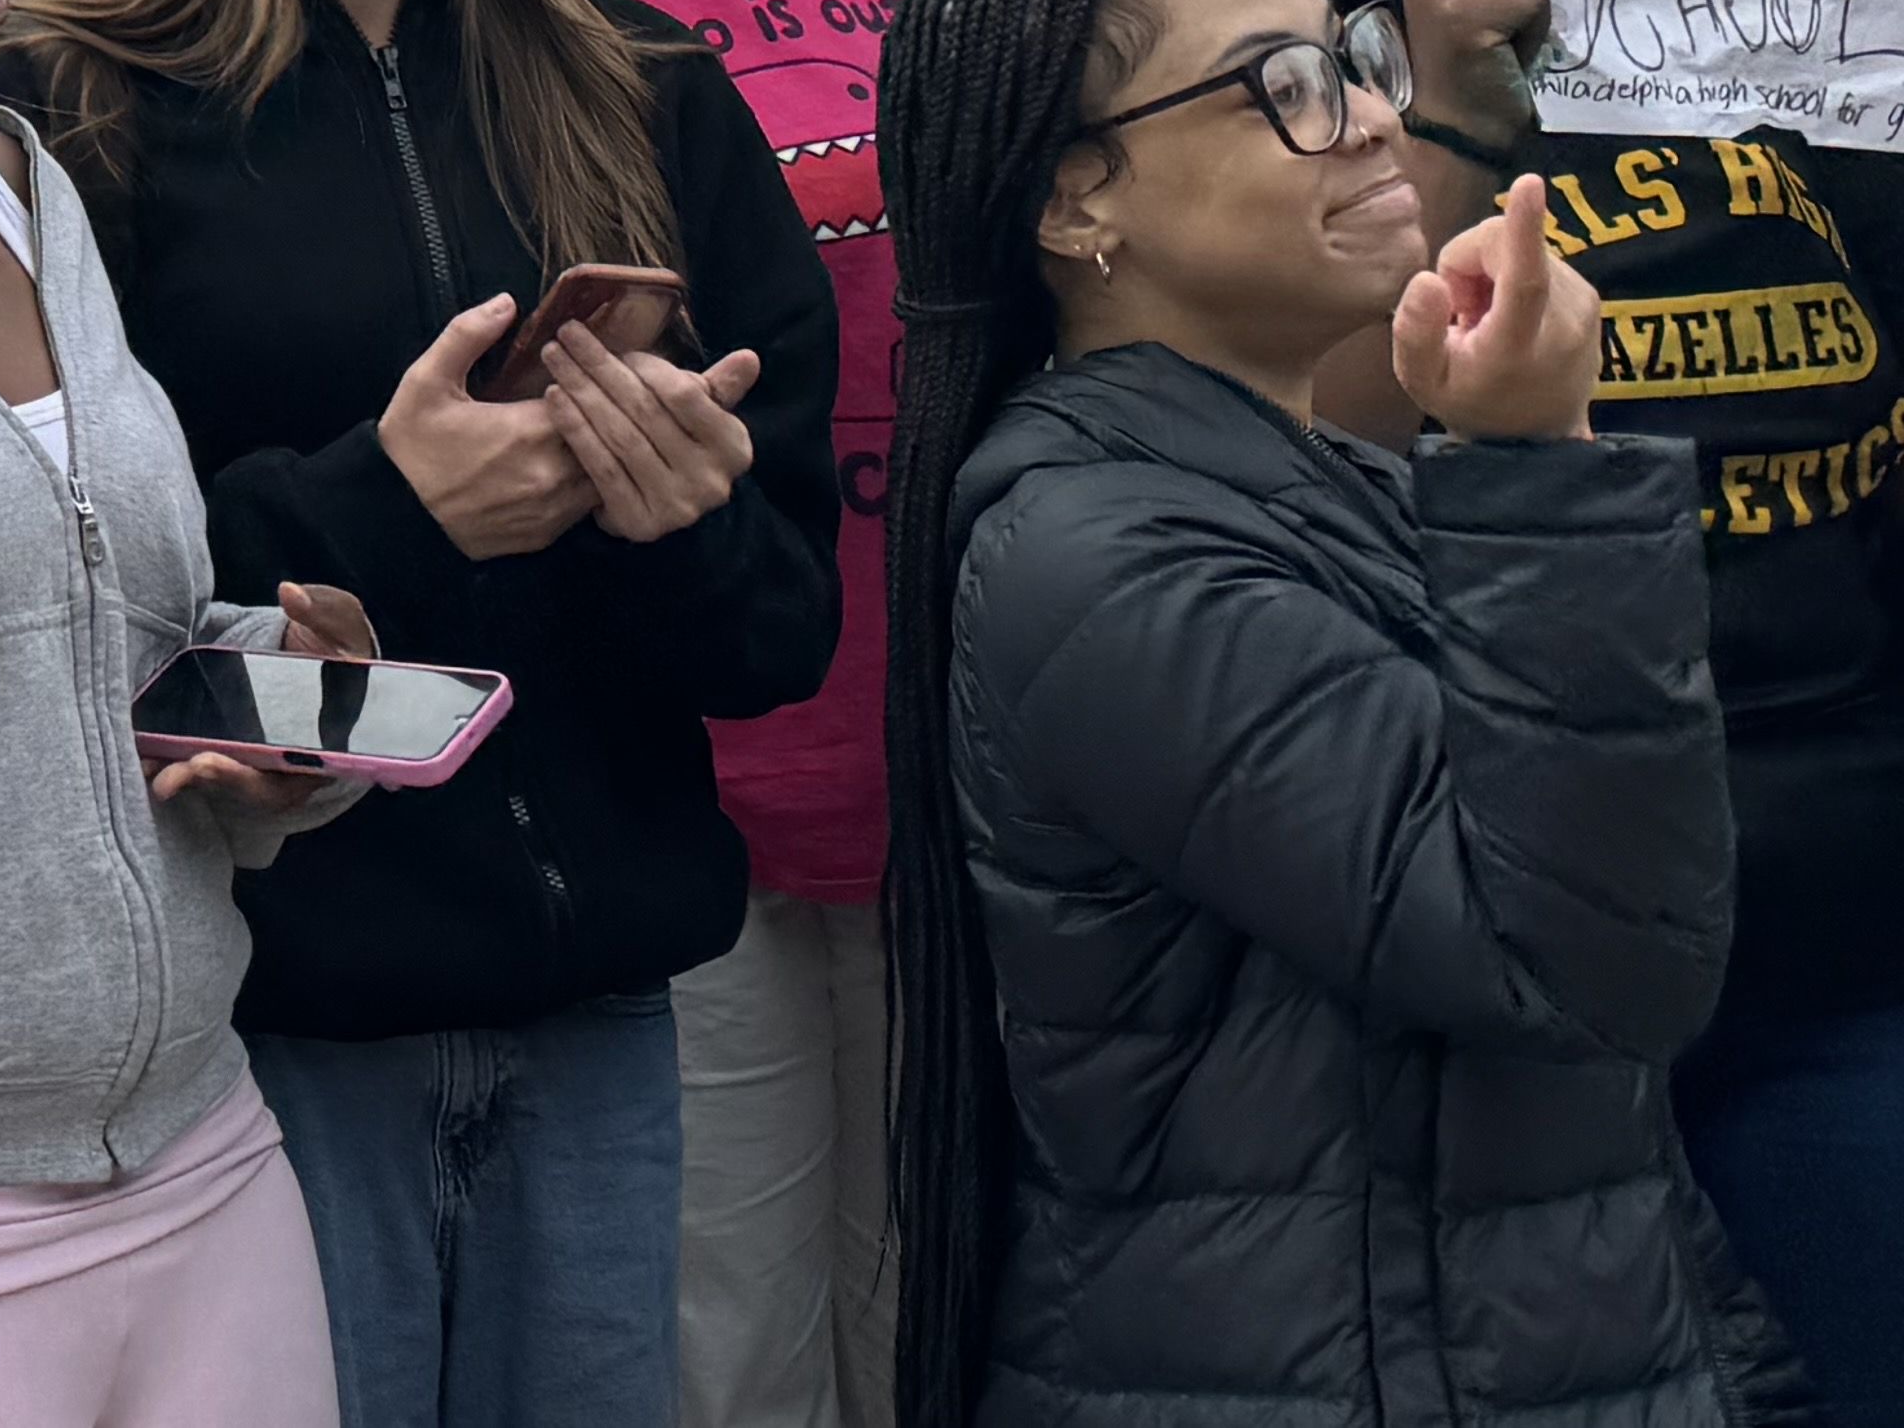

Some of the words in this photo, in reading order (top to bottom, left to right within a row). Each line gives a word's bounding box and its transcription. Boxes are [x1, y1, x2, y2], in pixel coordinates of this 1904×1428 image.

[1696, 75, 1748, 109] high
[1754, 83, 1828, 119] school
[1837, 92, 1876, 127] for
[1598, 296, 1865, 384] AZELLES
